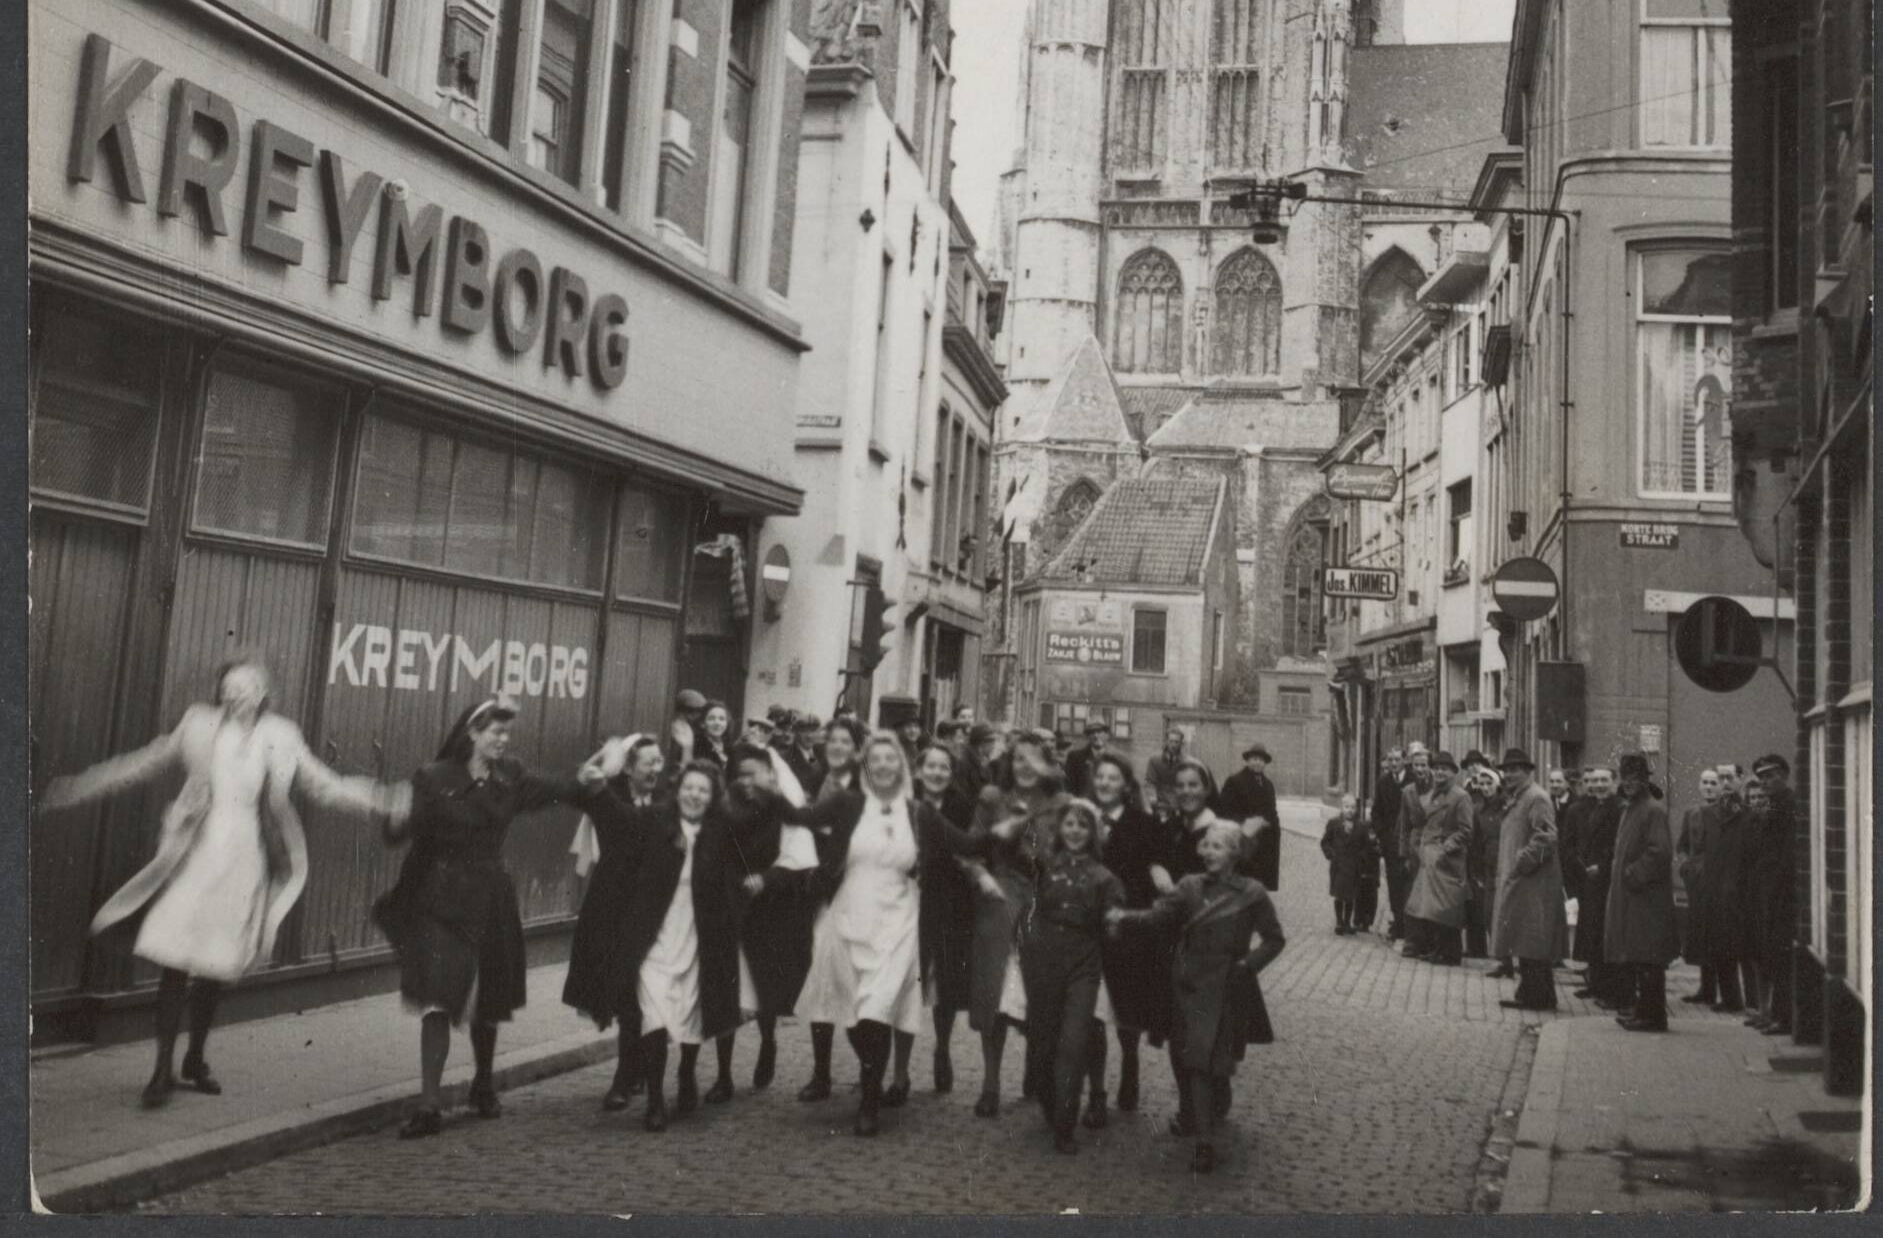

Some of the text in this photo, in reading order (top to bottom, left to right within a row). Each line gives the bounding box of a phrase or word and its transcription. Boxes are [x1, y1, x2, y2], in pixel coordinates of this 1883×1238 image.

[67, 33, 630, 390] KREYMBORG
[1621, 524, 1651, 534] KORTE
[1627, 534, 1672, 546] STRAAT
[1349, 572, 1393, 595] KIMMEL
[328, 622, 588, 699] KREYMBORG
